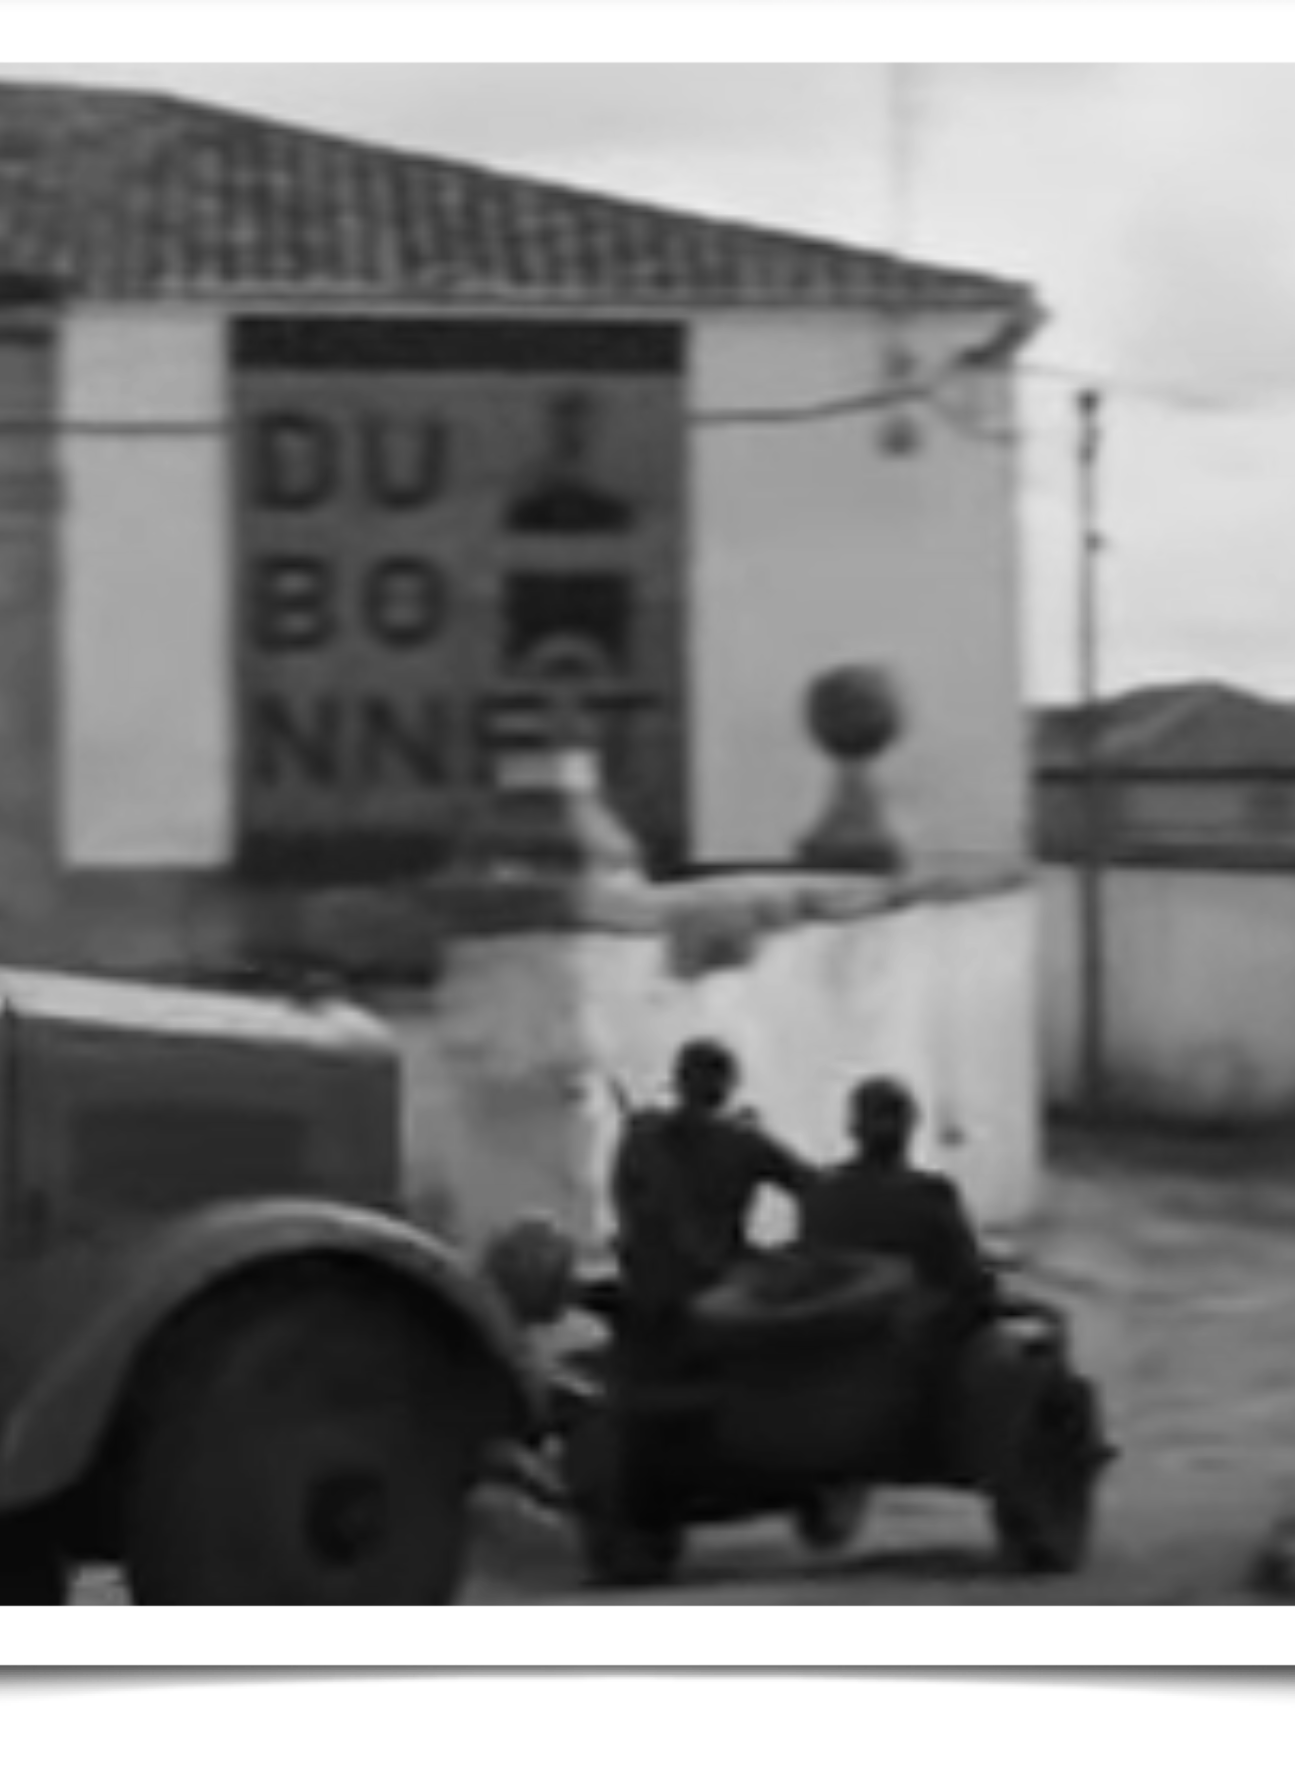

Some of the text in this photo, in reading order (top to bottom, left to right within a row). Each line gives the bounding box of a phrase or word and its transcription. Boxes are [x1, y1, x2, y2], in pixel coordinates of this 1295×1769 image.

[255, 411, 446, 508] DU
[253, 556, 444, 652] BO
[257, 694, 664, 787] NNET
